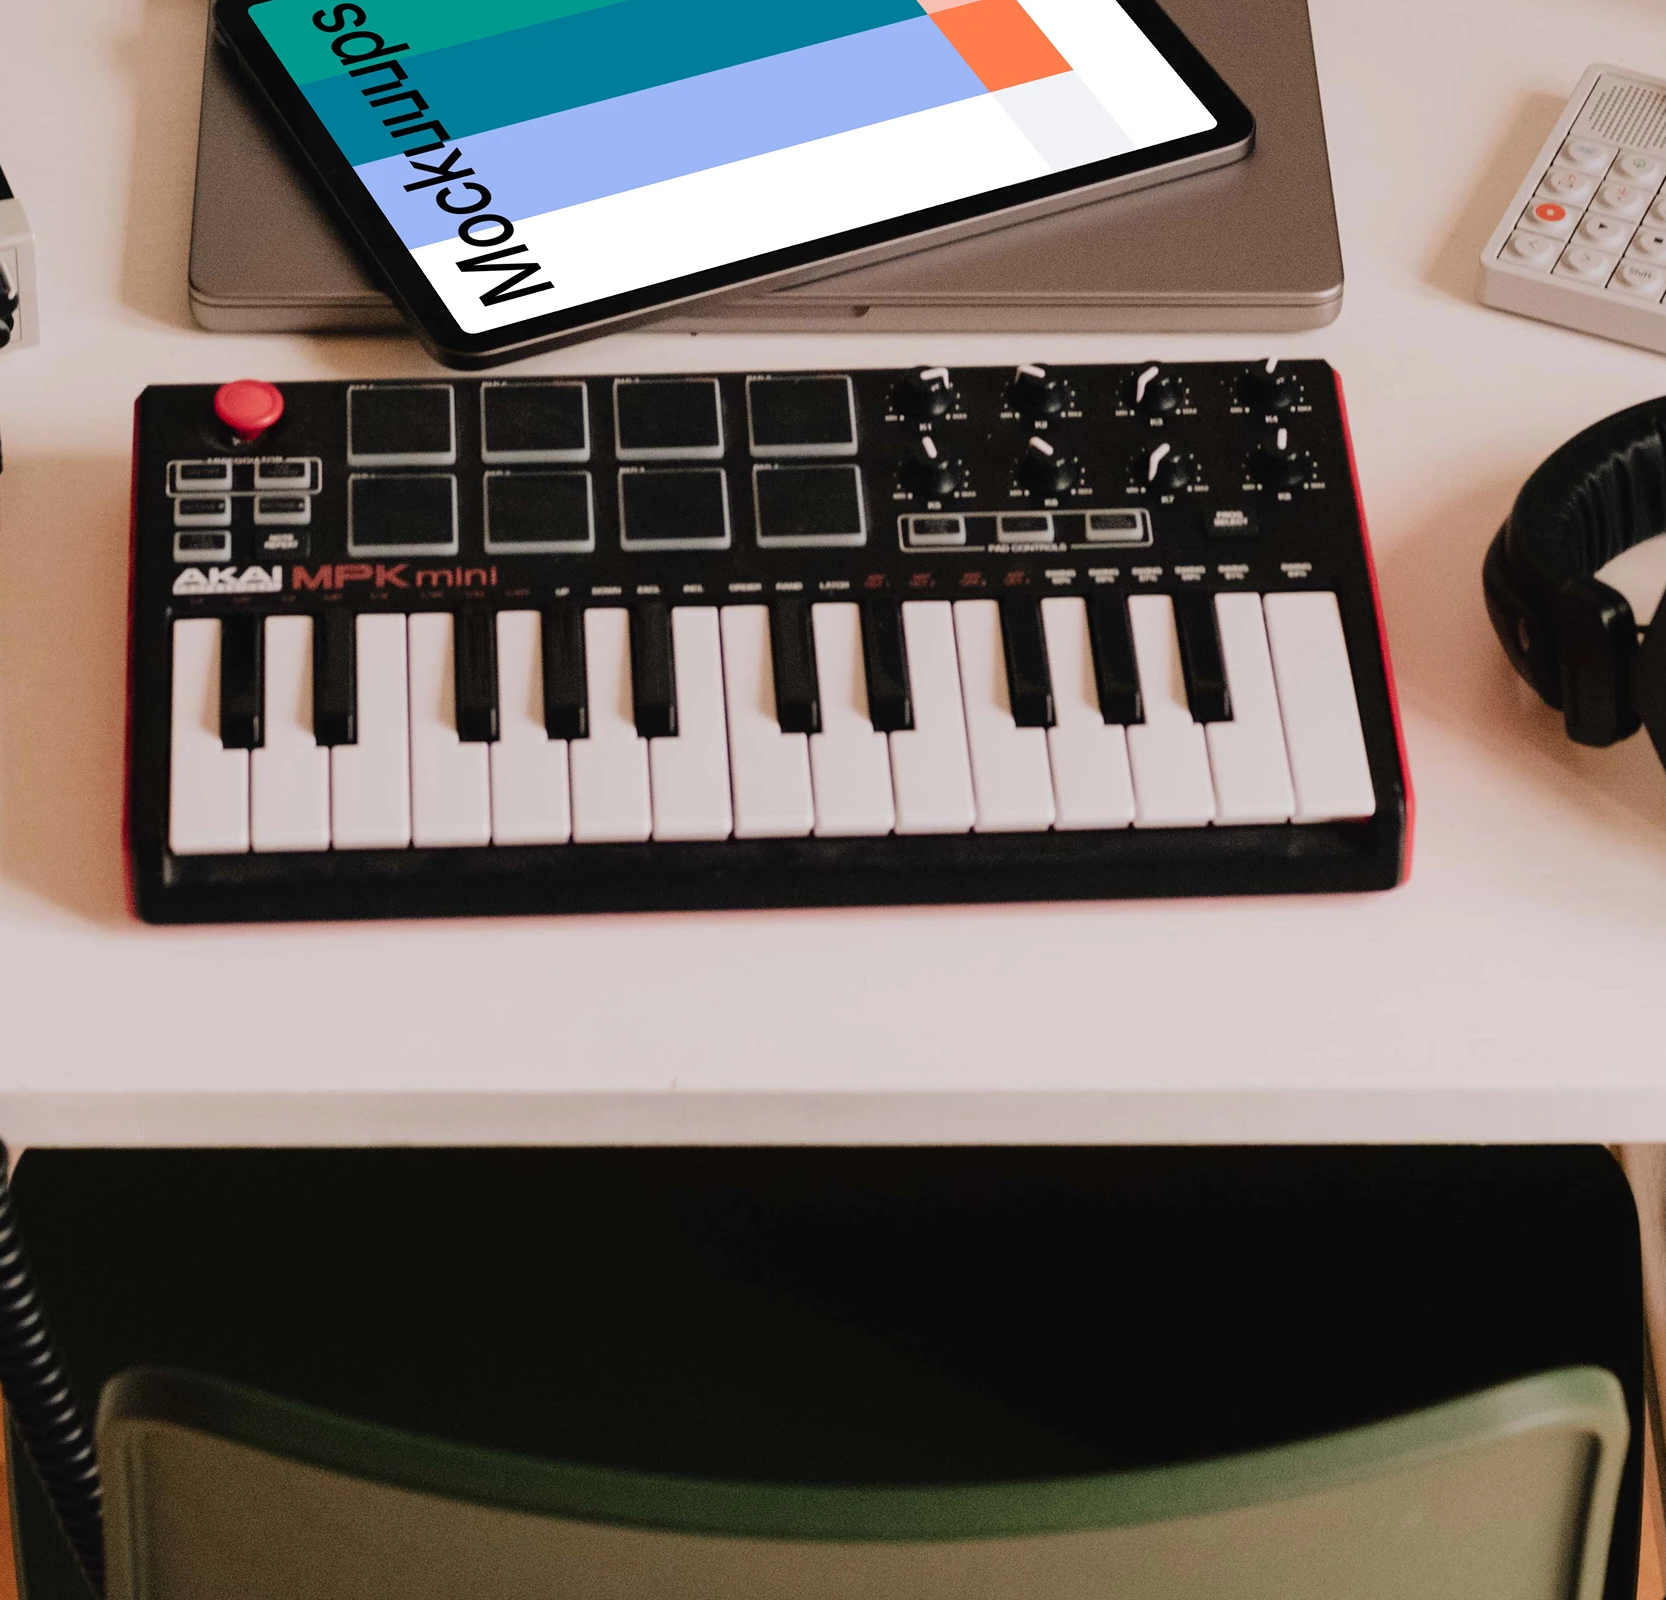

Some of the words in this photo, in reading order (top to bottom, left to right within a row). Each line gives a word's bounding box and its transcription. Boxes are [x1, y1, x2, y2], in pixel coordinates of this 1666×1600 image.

[313, 2, 555, 307] Mockuuups
[172, 565, 283, 592] AKAI
[292, 563, 410, 591] MPK
[415, 565, 498, 588] mini
